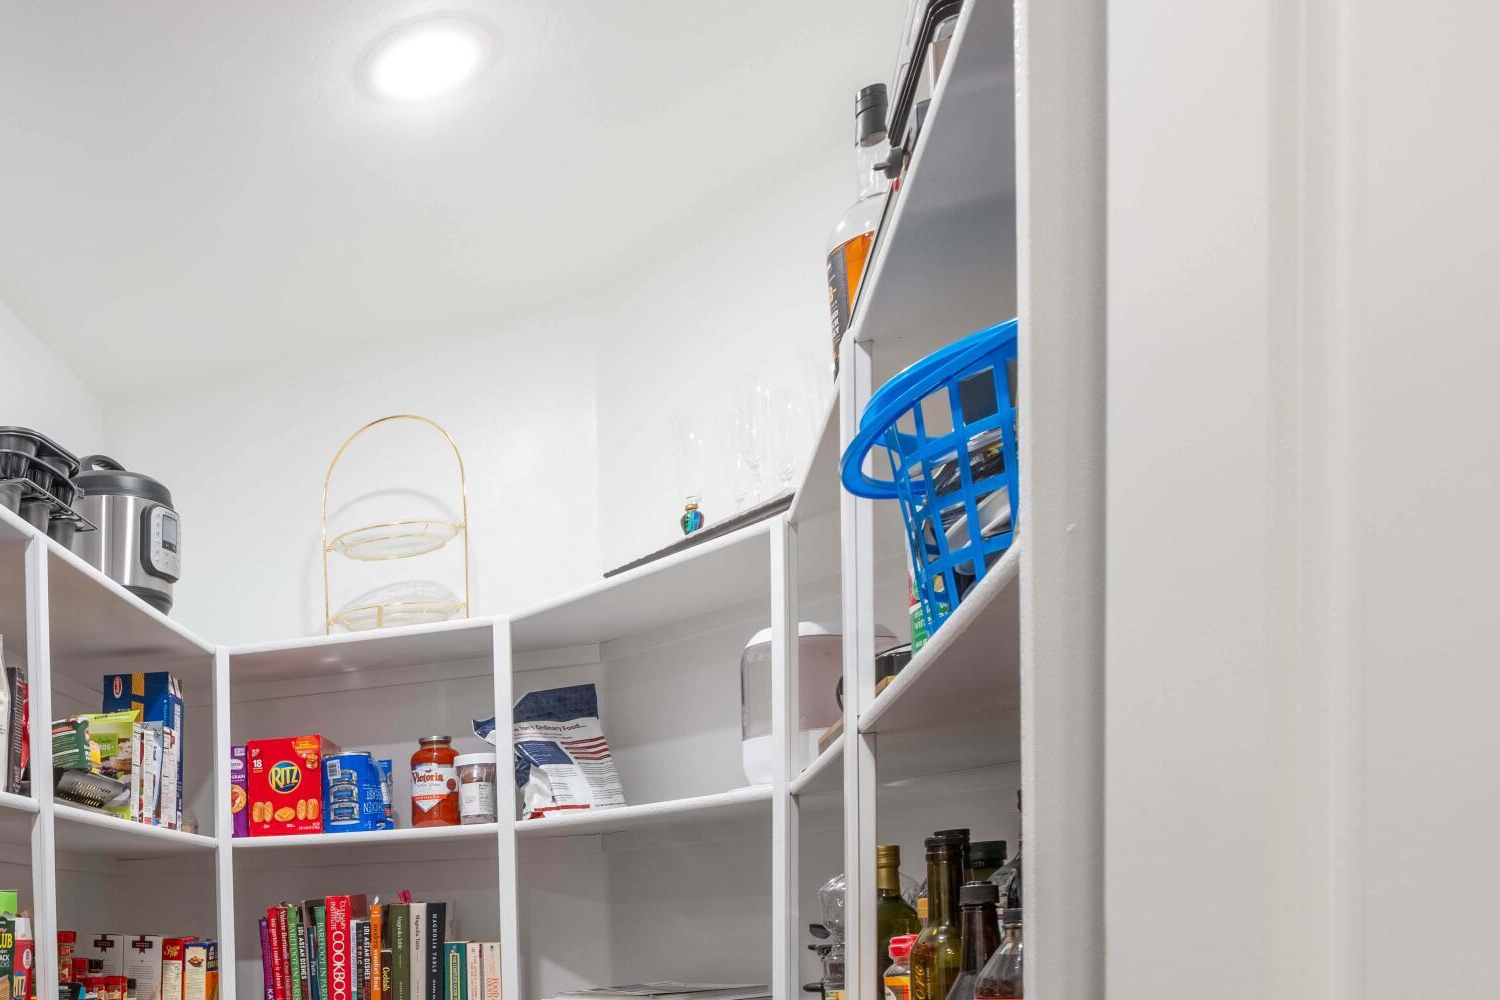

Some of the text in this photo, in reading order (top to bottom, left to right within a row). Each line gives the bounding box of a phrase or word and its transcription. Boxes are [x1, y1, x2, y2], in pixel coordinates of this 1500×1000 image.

[535, 724, 562, 733] Ordinary
[252, 759, 263, 768] 18
[269, 765, 300, 787] RITZ
[411, 770, 444, 783] Victoria
